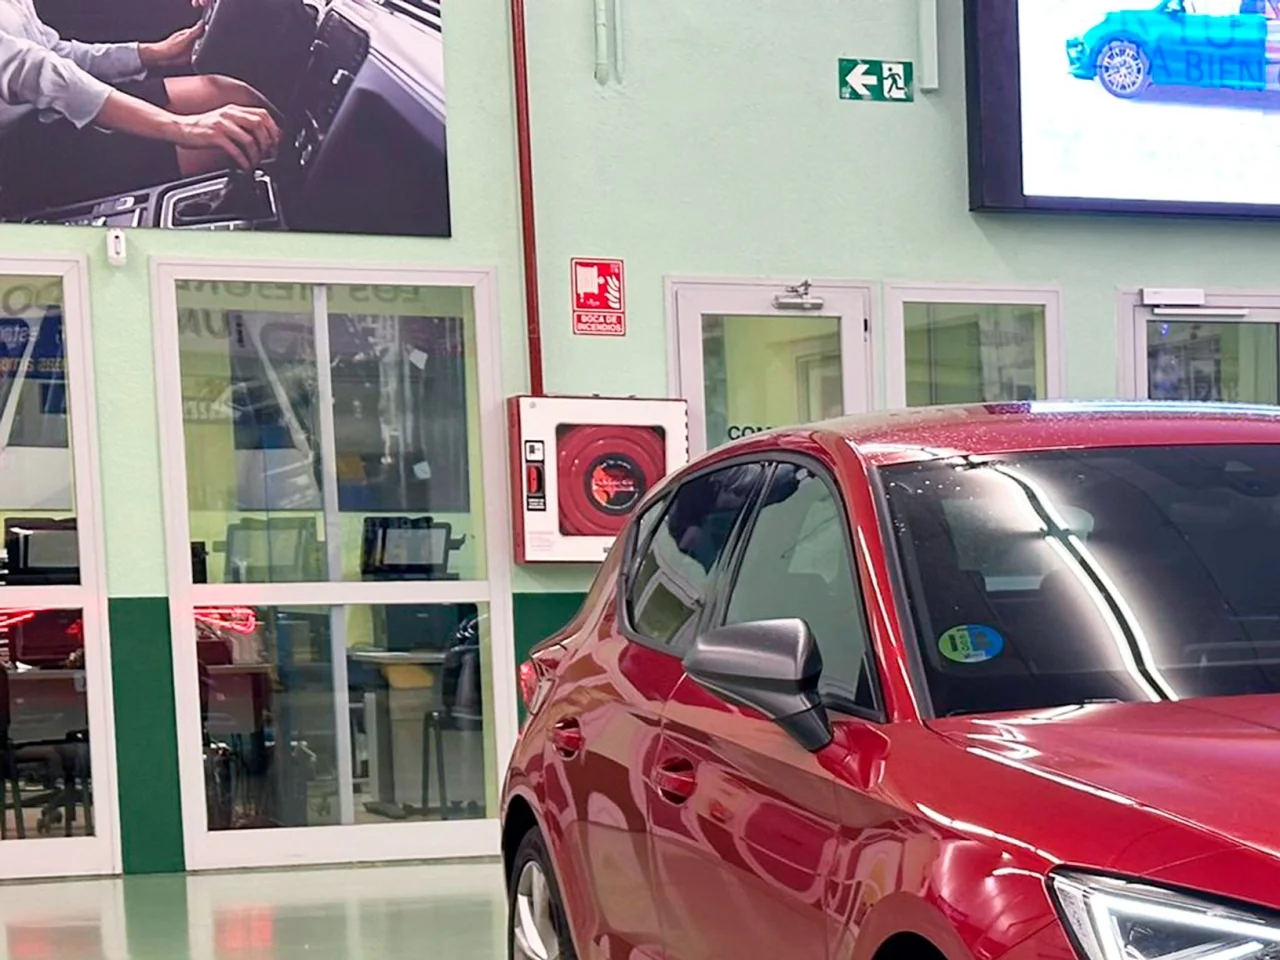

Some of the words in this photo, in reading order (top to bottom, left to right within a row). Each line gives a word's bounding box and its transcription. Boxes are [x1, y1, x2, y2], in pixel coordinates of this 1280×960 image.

[581, 315, 604, 323] BOCA
[606, 315, 618, 324] DE
[577, 323, 622, 332] INCENDIOS
